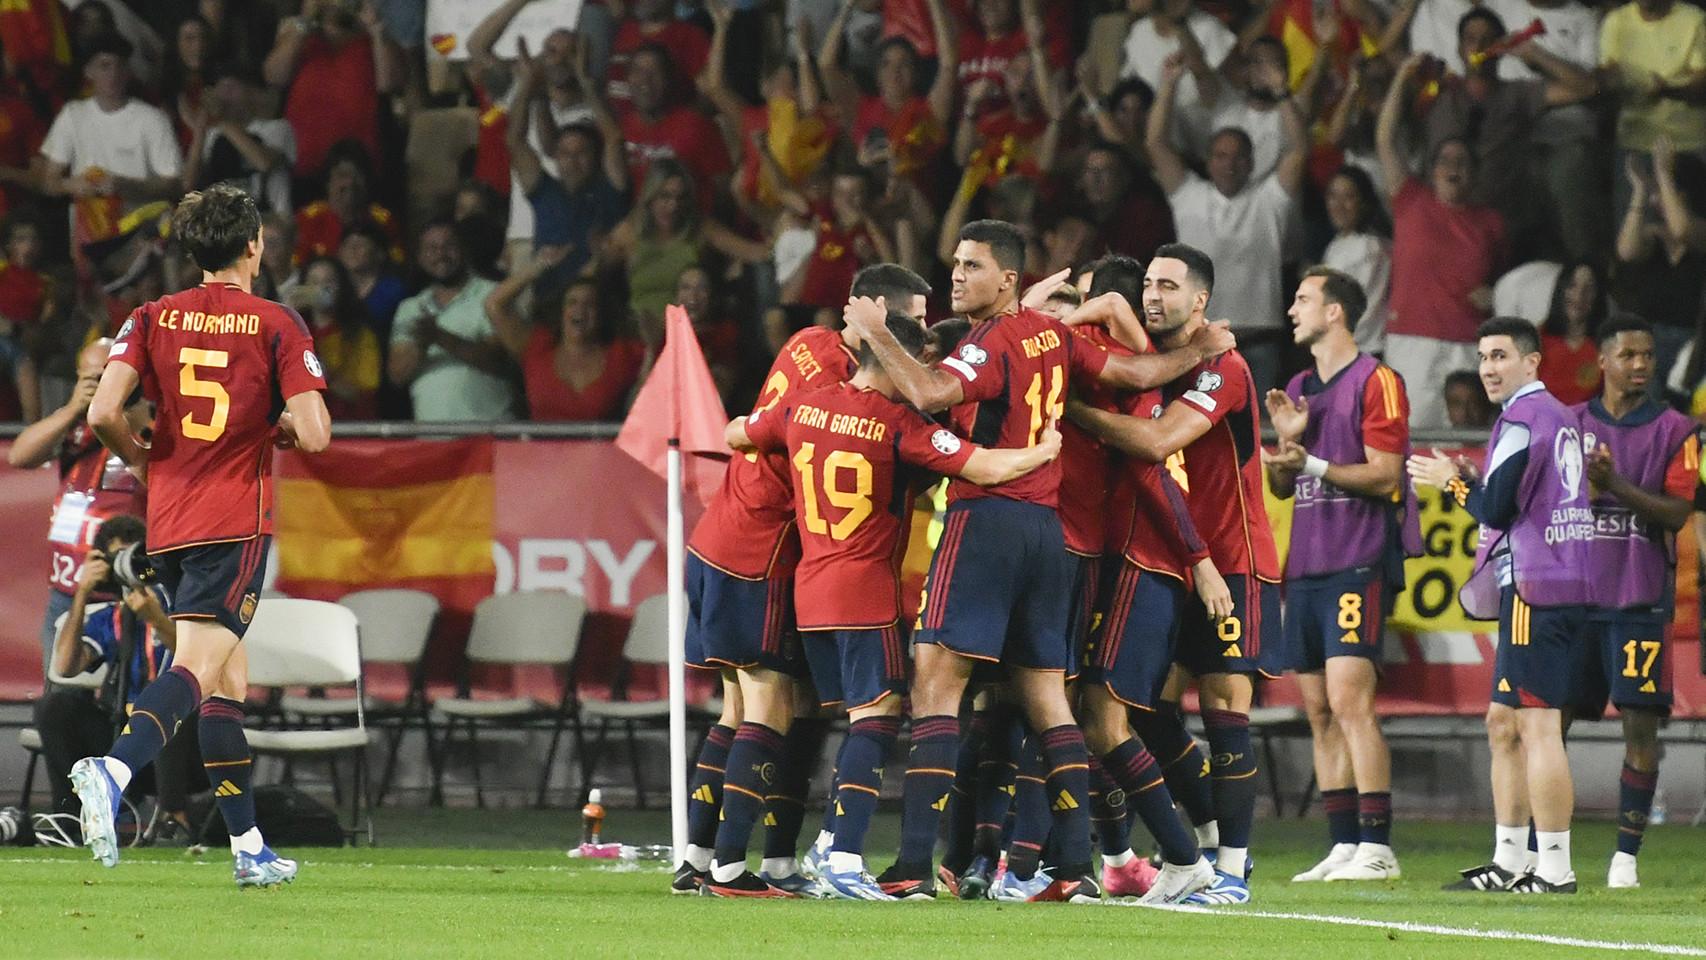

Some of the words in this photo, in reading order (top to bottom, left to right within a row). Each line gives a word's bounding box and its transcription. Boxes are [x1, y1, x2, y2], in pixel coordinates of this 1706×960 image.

[158, 309, 180, 330] LE
[182, 311, 260, 335] NORMAND
[178, 347, 230, 442] 5
[793, 404, 829, 430] FRAN
[830, 413, 886, 442] GARCÍA
[793, 441, 873, 541] 19
[1338, 592, 1362, 630] 8
[1622, 639, 1661, 678] 17
